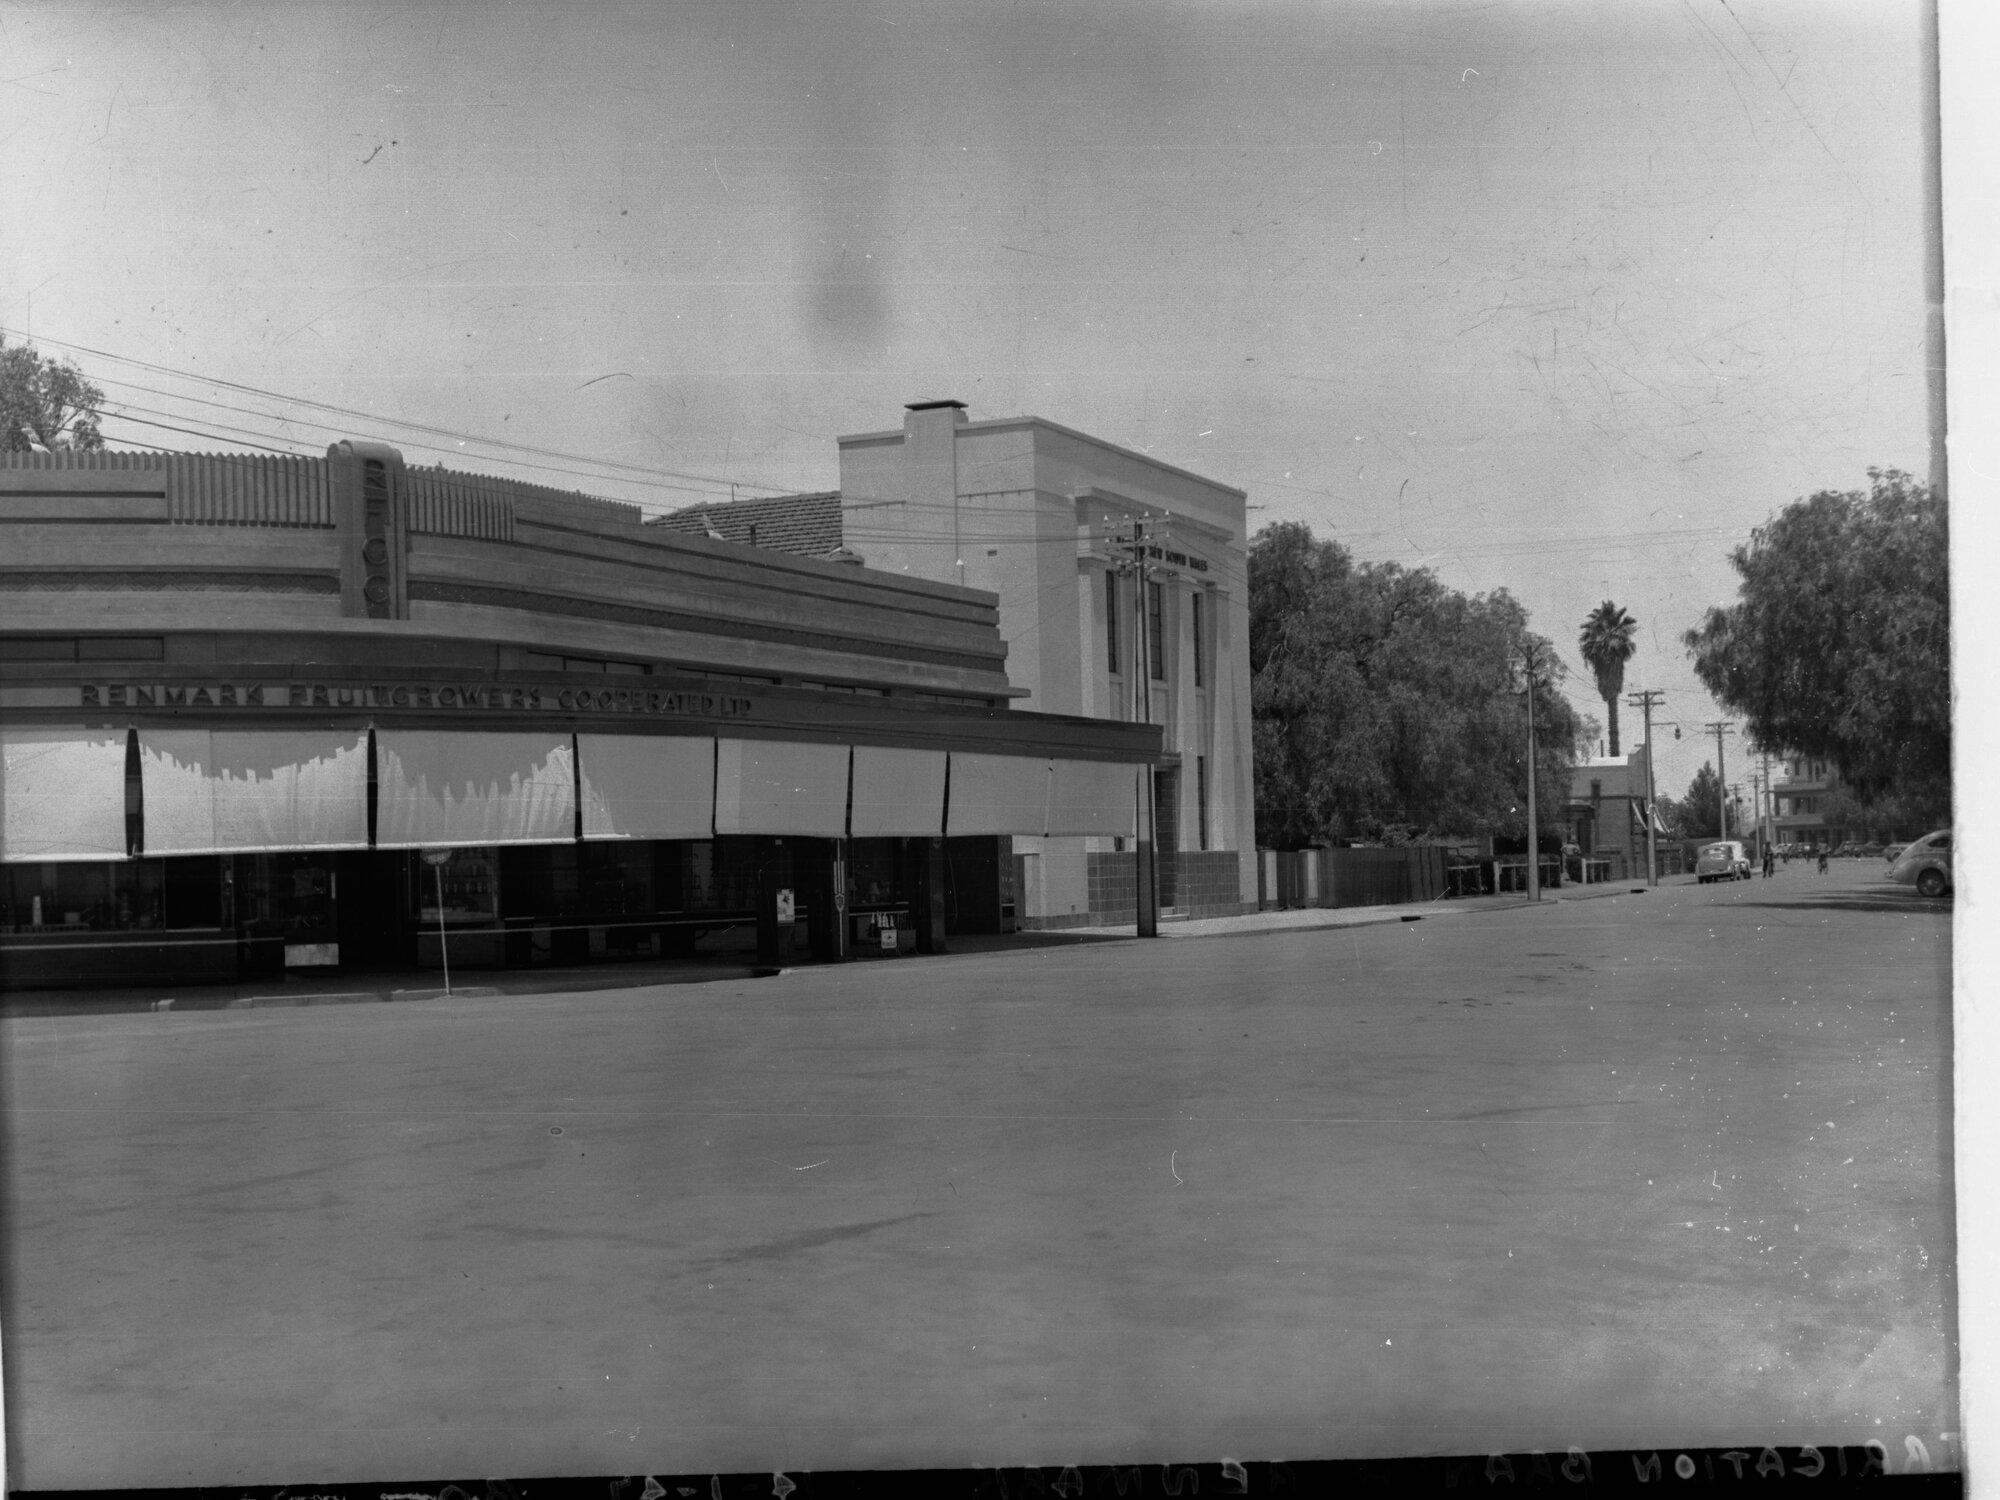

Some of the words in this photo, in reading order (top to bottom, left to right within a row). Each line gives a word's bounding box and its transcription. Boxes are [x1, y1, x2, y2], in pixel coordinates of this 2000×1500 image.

[82, 682, 263, 706] RENMARK
[289, 683, 541, 708] FRUITGROWERS
[721, 697, 751, 717] LTD
